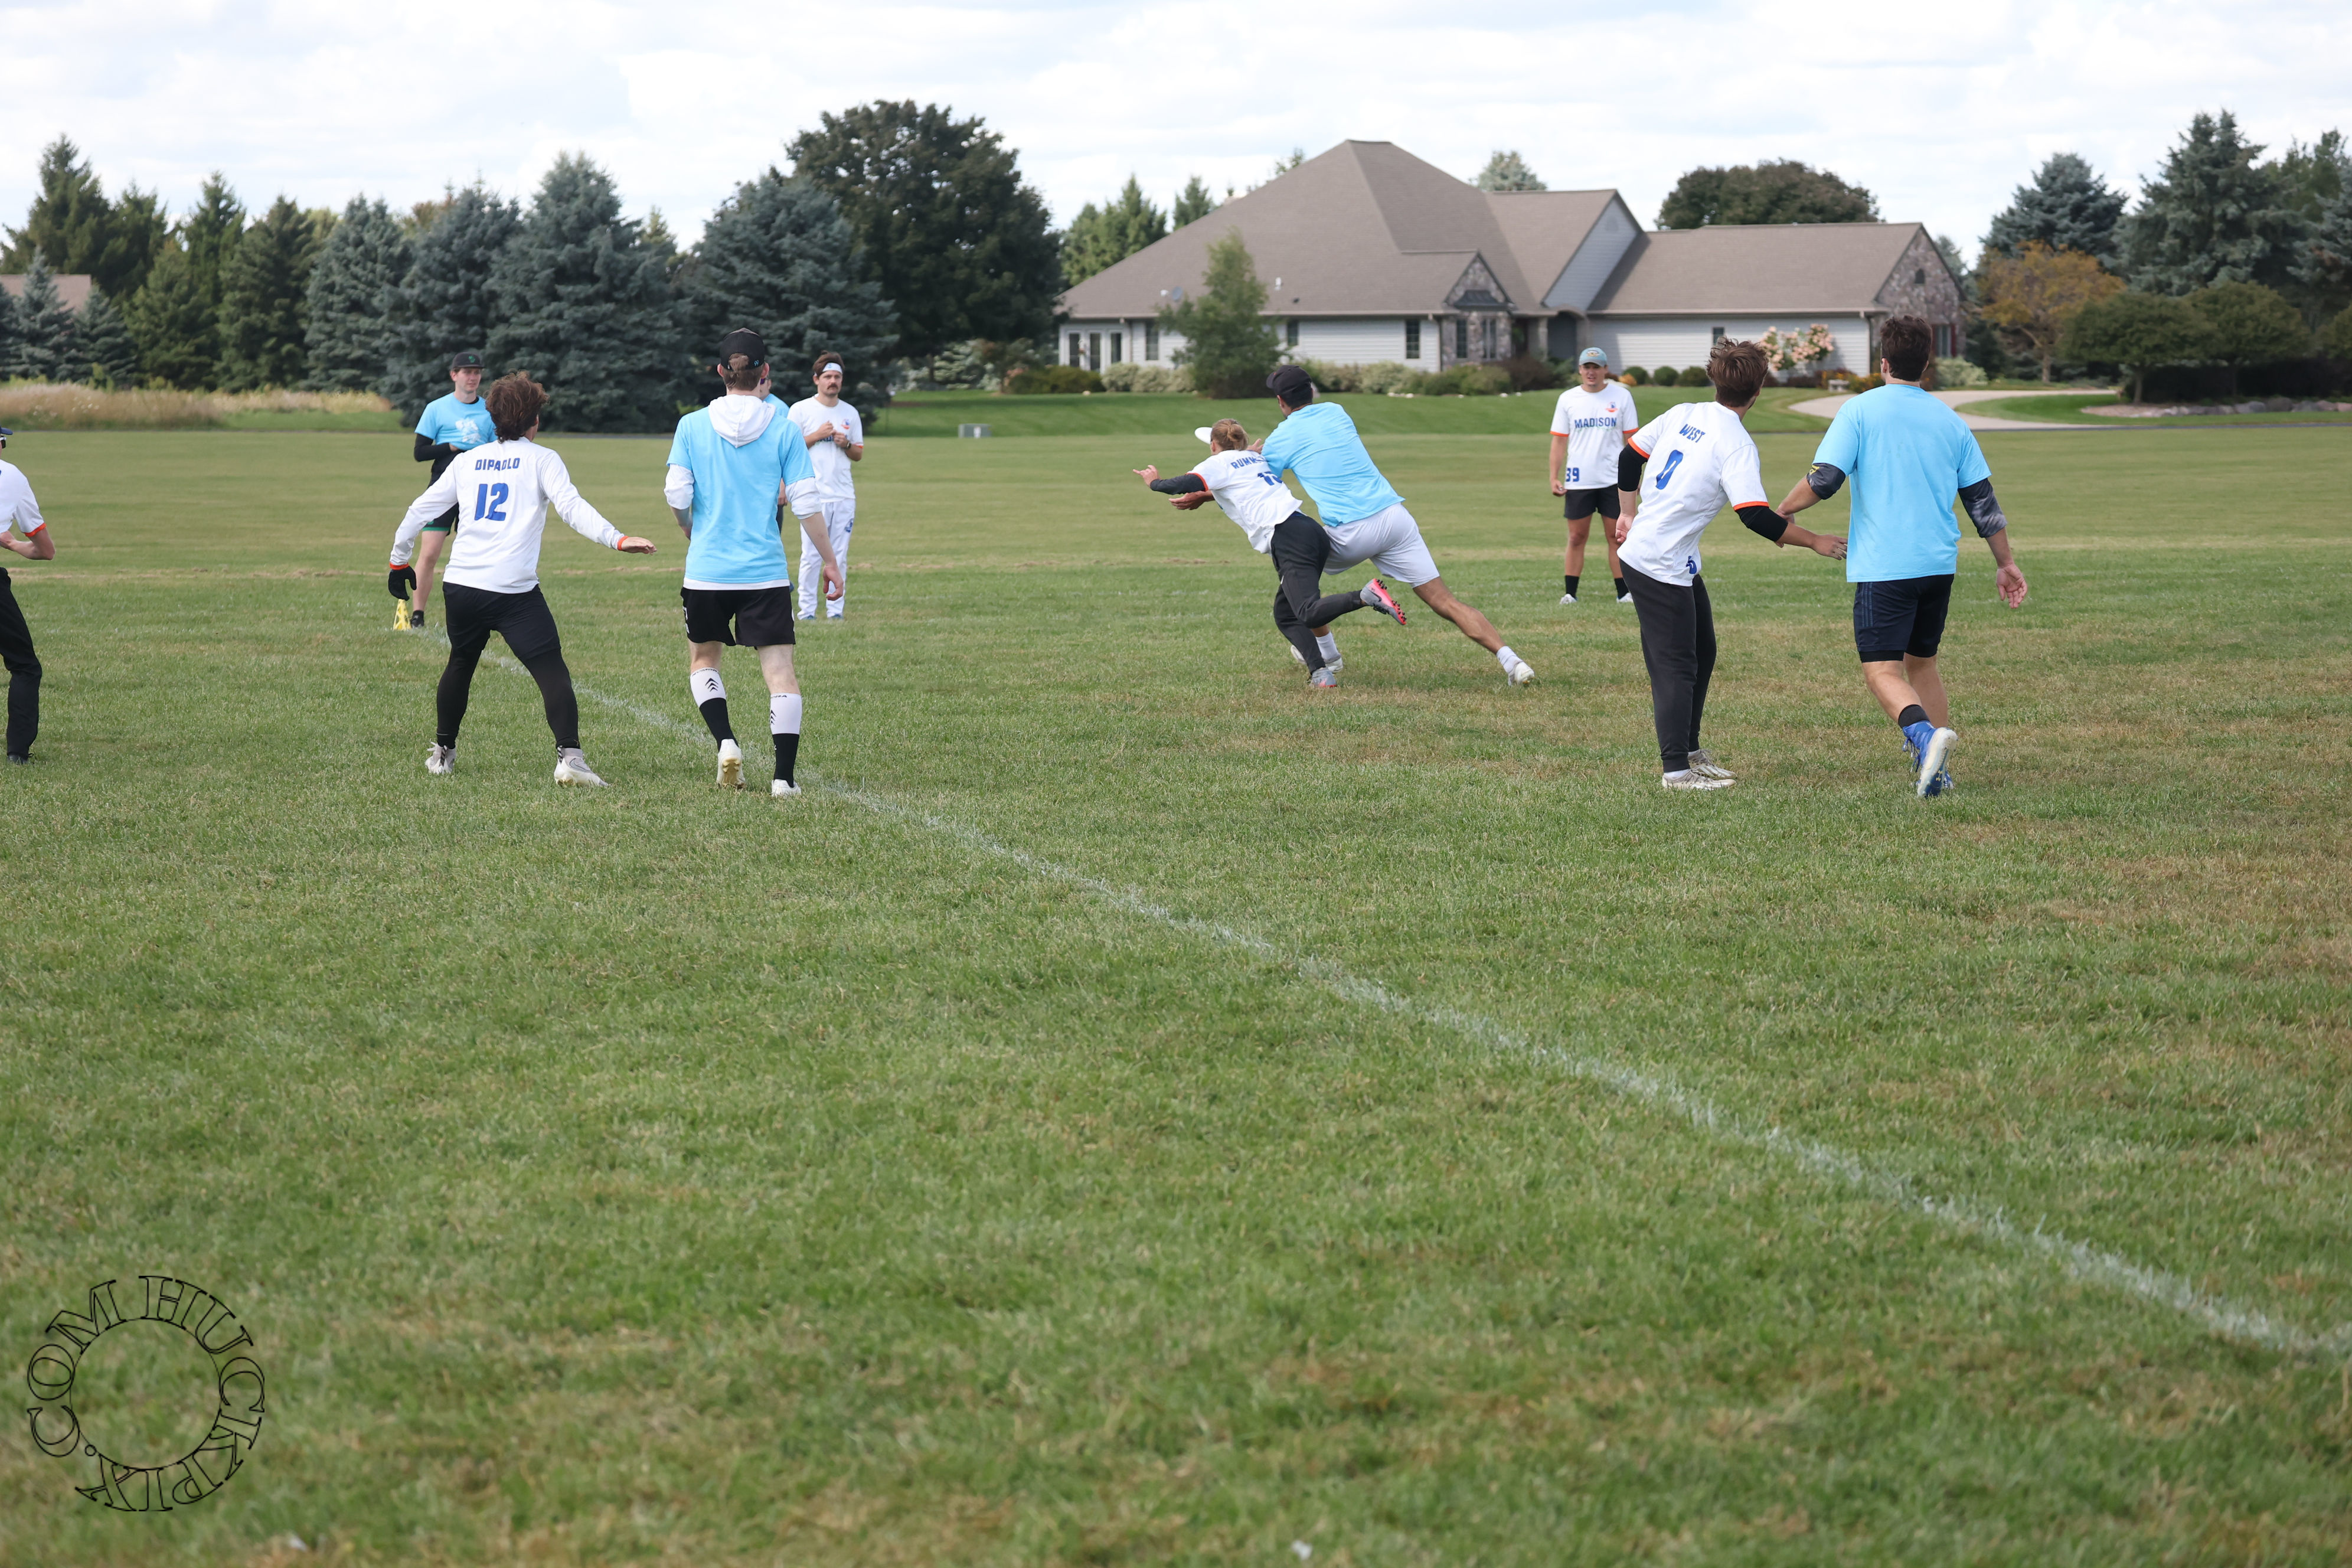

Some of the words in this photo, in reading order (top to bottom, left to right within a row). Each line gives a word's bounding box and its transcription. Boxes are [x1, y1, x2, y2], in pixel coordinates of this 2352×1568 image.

[1574, 417, 1617, 429] MADISON
[1679, 423, 1706, 443] WEST
[475, 458, 520, 471] DIPAOLO
[1655, 449, 1684, 490] 0
[1566, 467, 1579, 482] 39
[474, 482, 508, 521] 12
